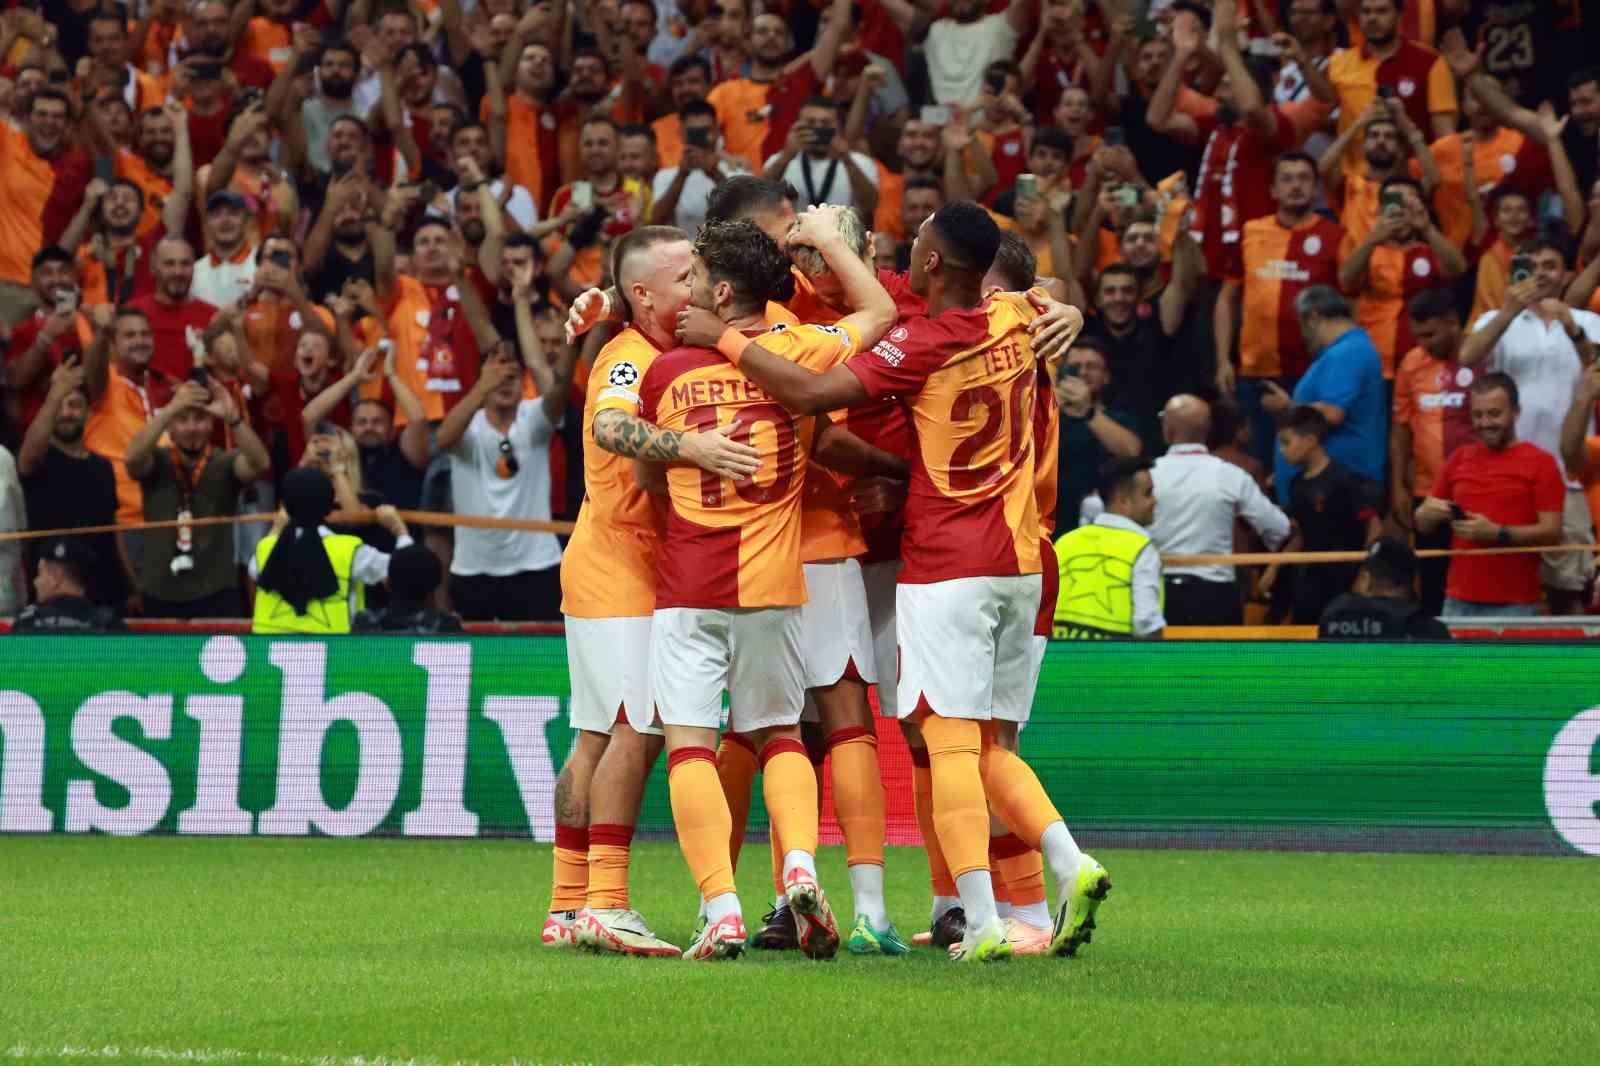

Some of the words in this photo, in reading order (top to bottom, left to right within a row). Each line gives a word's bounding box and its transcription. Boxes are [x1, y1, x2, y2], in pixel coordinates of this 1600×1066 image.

[1489, 26, 1534, 67] 23
[983, 342, 1024, 376] TETE
[671, 378, 770, 410] MERTE
[684, 404, 796, 508] 10
